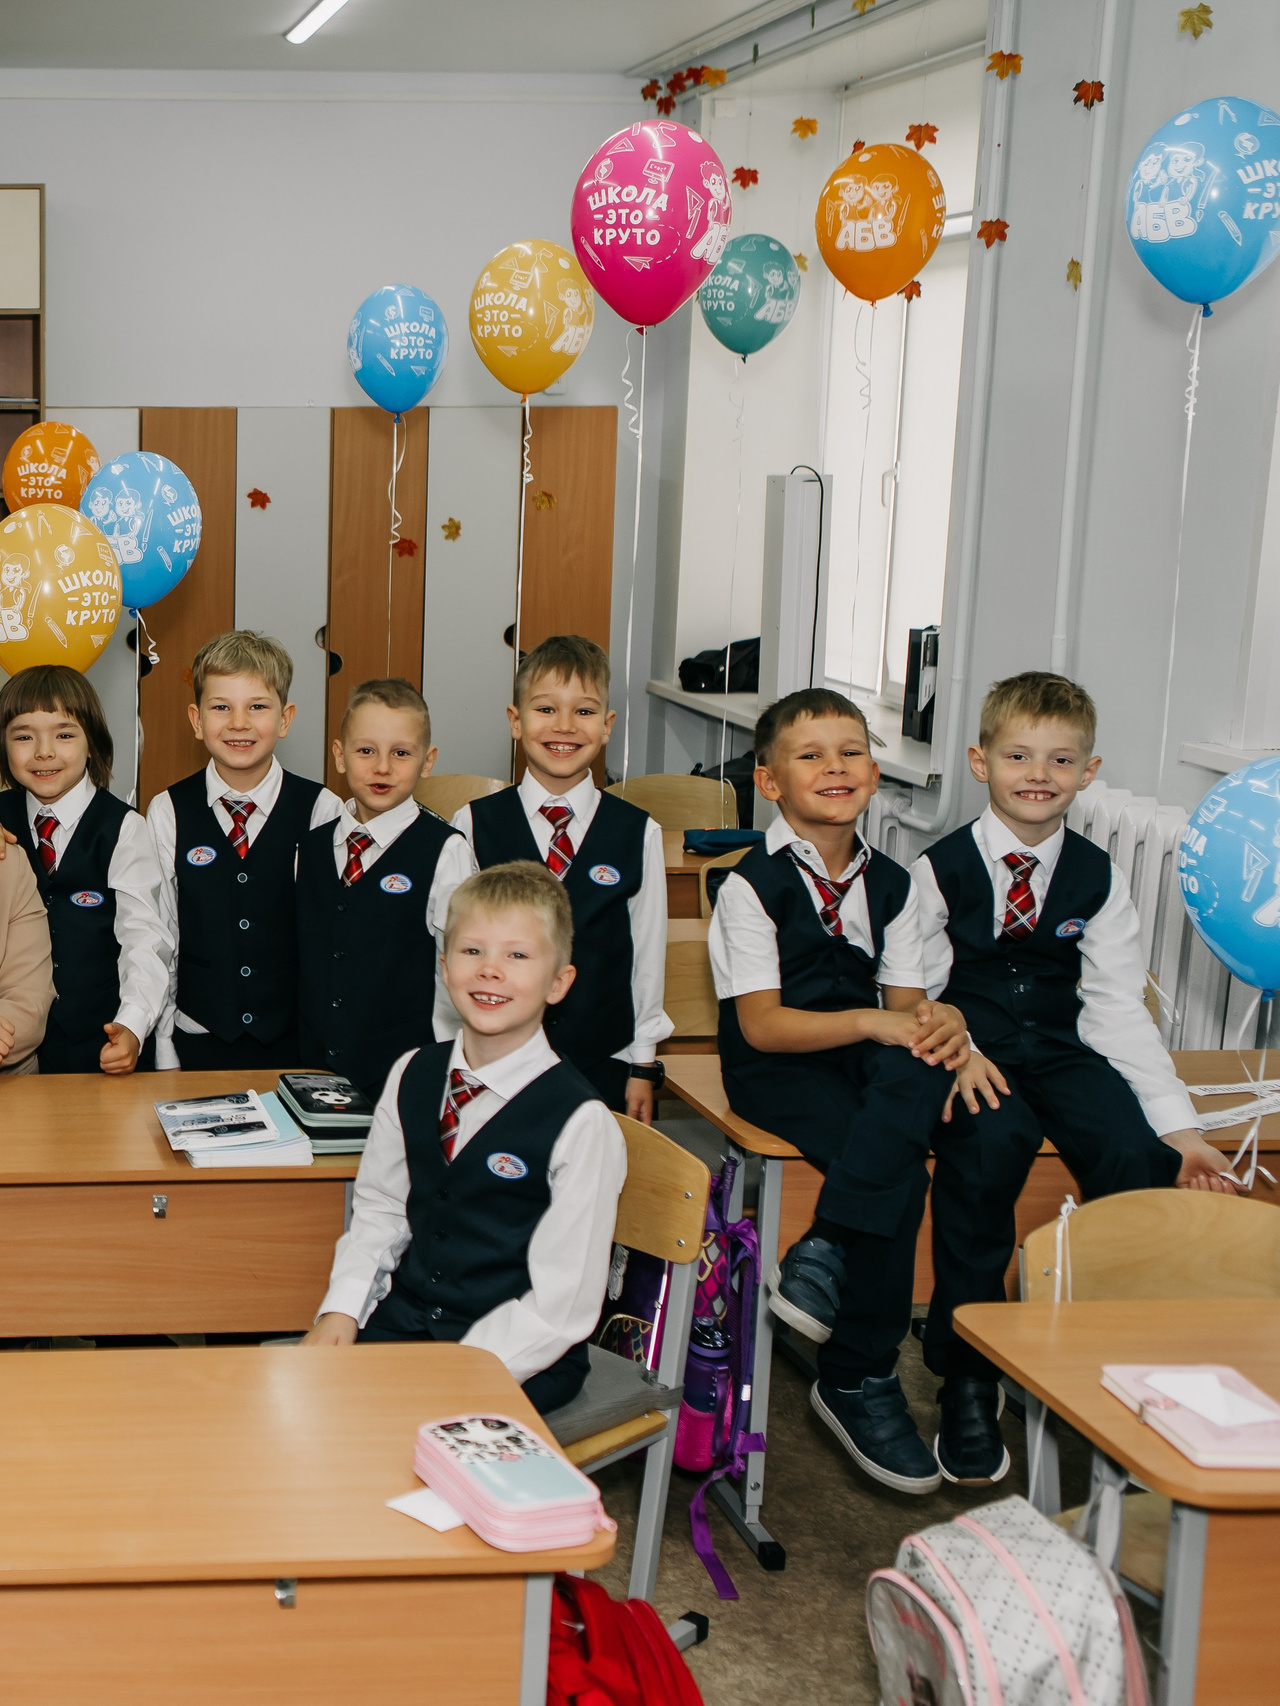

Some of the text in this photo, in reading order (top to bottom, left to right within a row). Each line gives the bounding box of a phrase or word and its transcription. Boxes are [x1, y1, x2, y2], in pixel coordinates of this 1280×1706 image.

[587, 185, 669, 212] ШКОЛА
[1130, 200, 1198, 243] АБВ
[593, 228, 661, 245] КРУТО
[835, 219, 897, 252] АБВ
[474, 291, 528, 312] ШКОЛА
[702, 300, 735, 311] КРУТО
[383, 321, 437, 338] ШКОЛА
[477, 324, 523, 338] КРУТО
[390, 347, 434, 360] КРУТО
[16, 462, 67, 479] ШКОЛА
[20, 487, 63, 500] КРУТО
[57, 569, 119, 594] ШКОЛА
[65, 608, 116, 626] КРУТО
